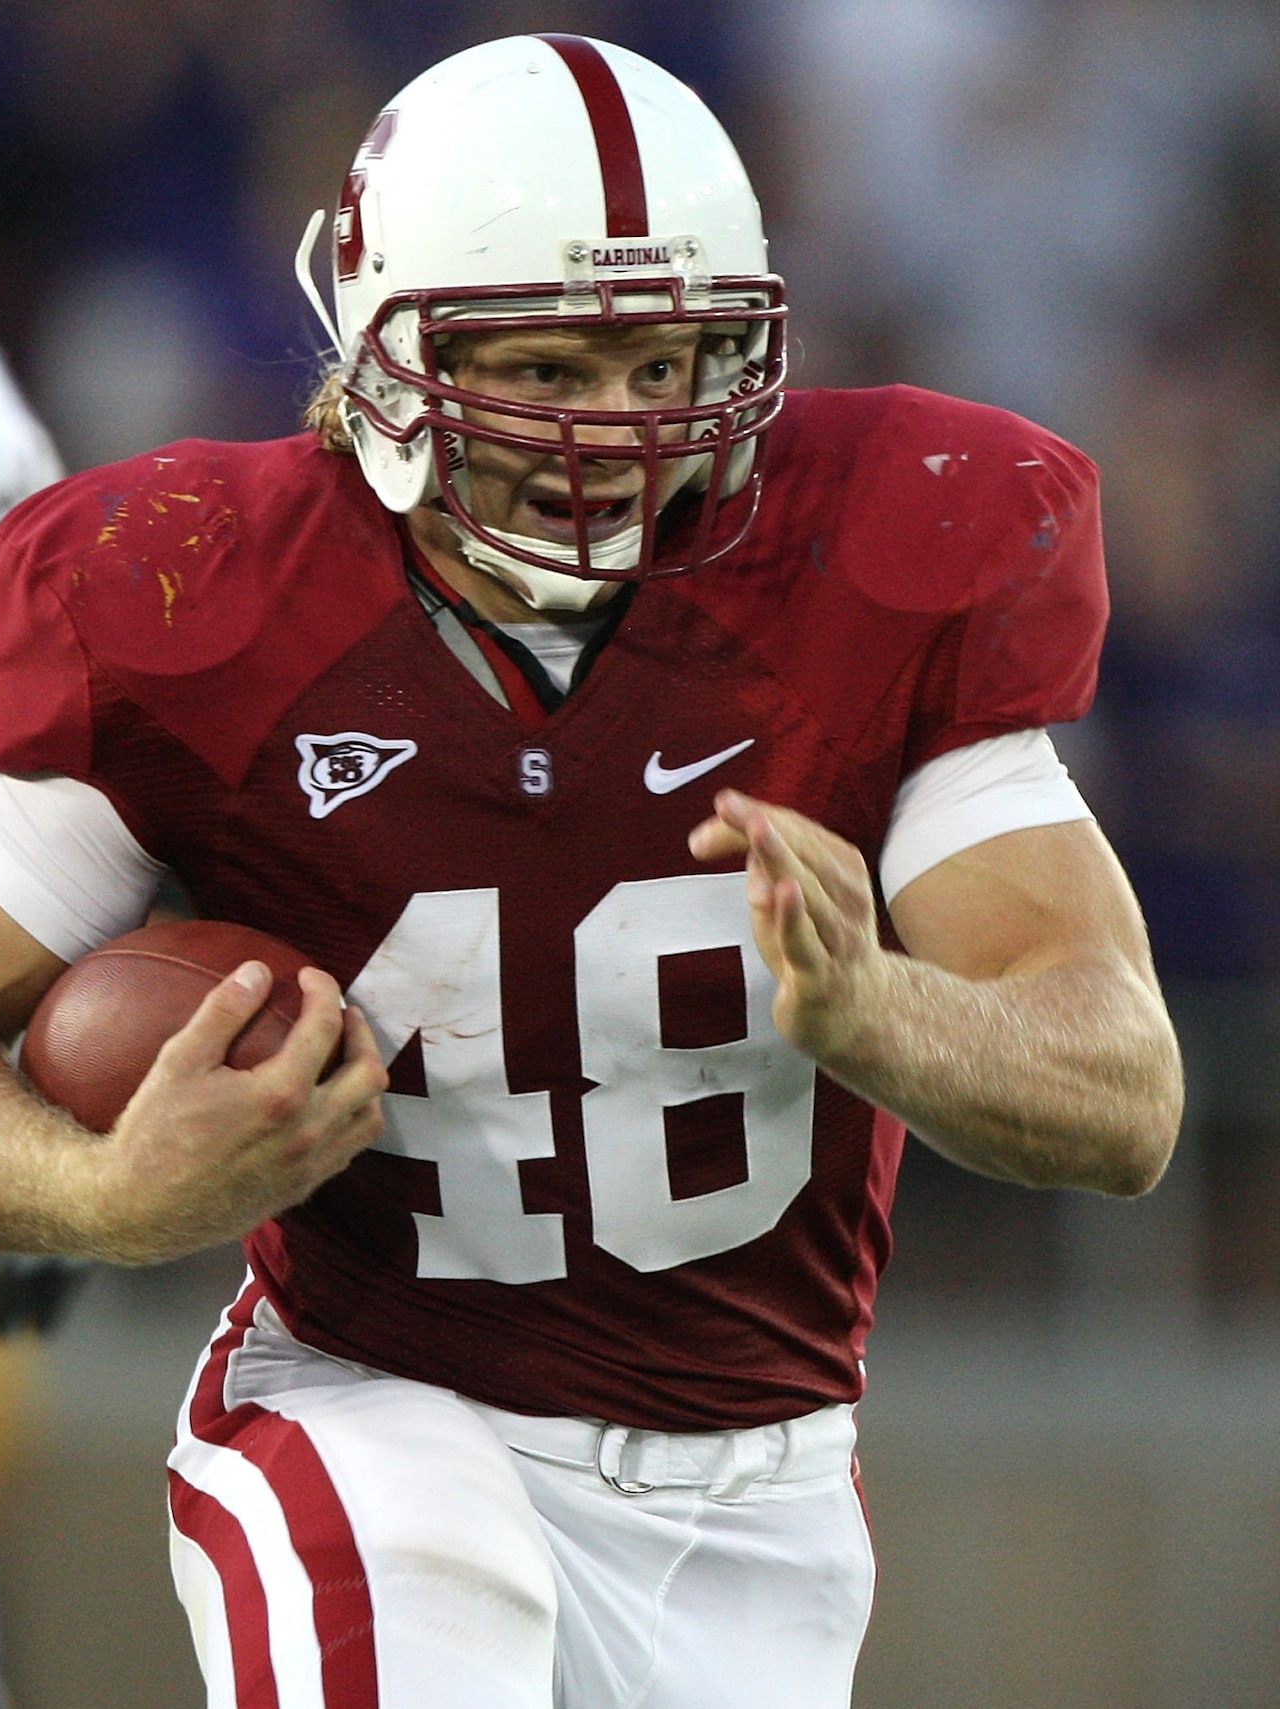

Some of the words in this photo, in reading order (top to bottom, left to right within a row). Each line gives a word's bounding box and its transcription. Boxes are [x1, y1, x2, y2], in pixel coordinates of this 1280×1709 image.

[593, 246, 670, 266] CARDINAL
[520, 748, 552, 796] S
[342, 871, 817, 1284] 48
